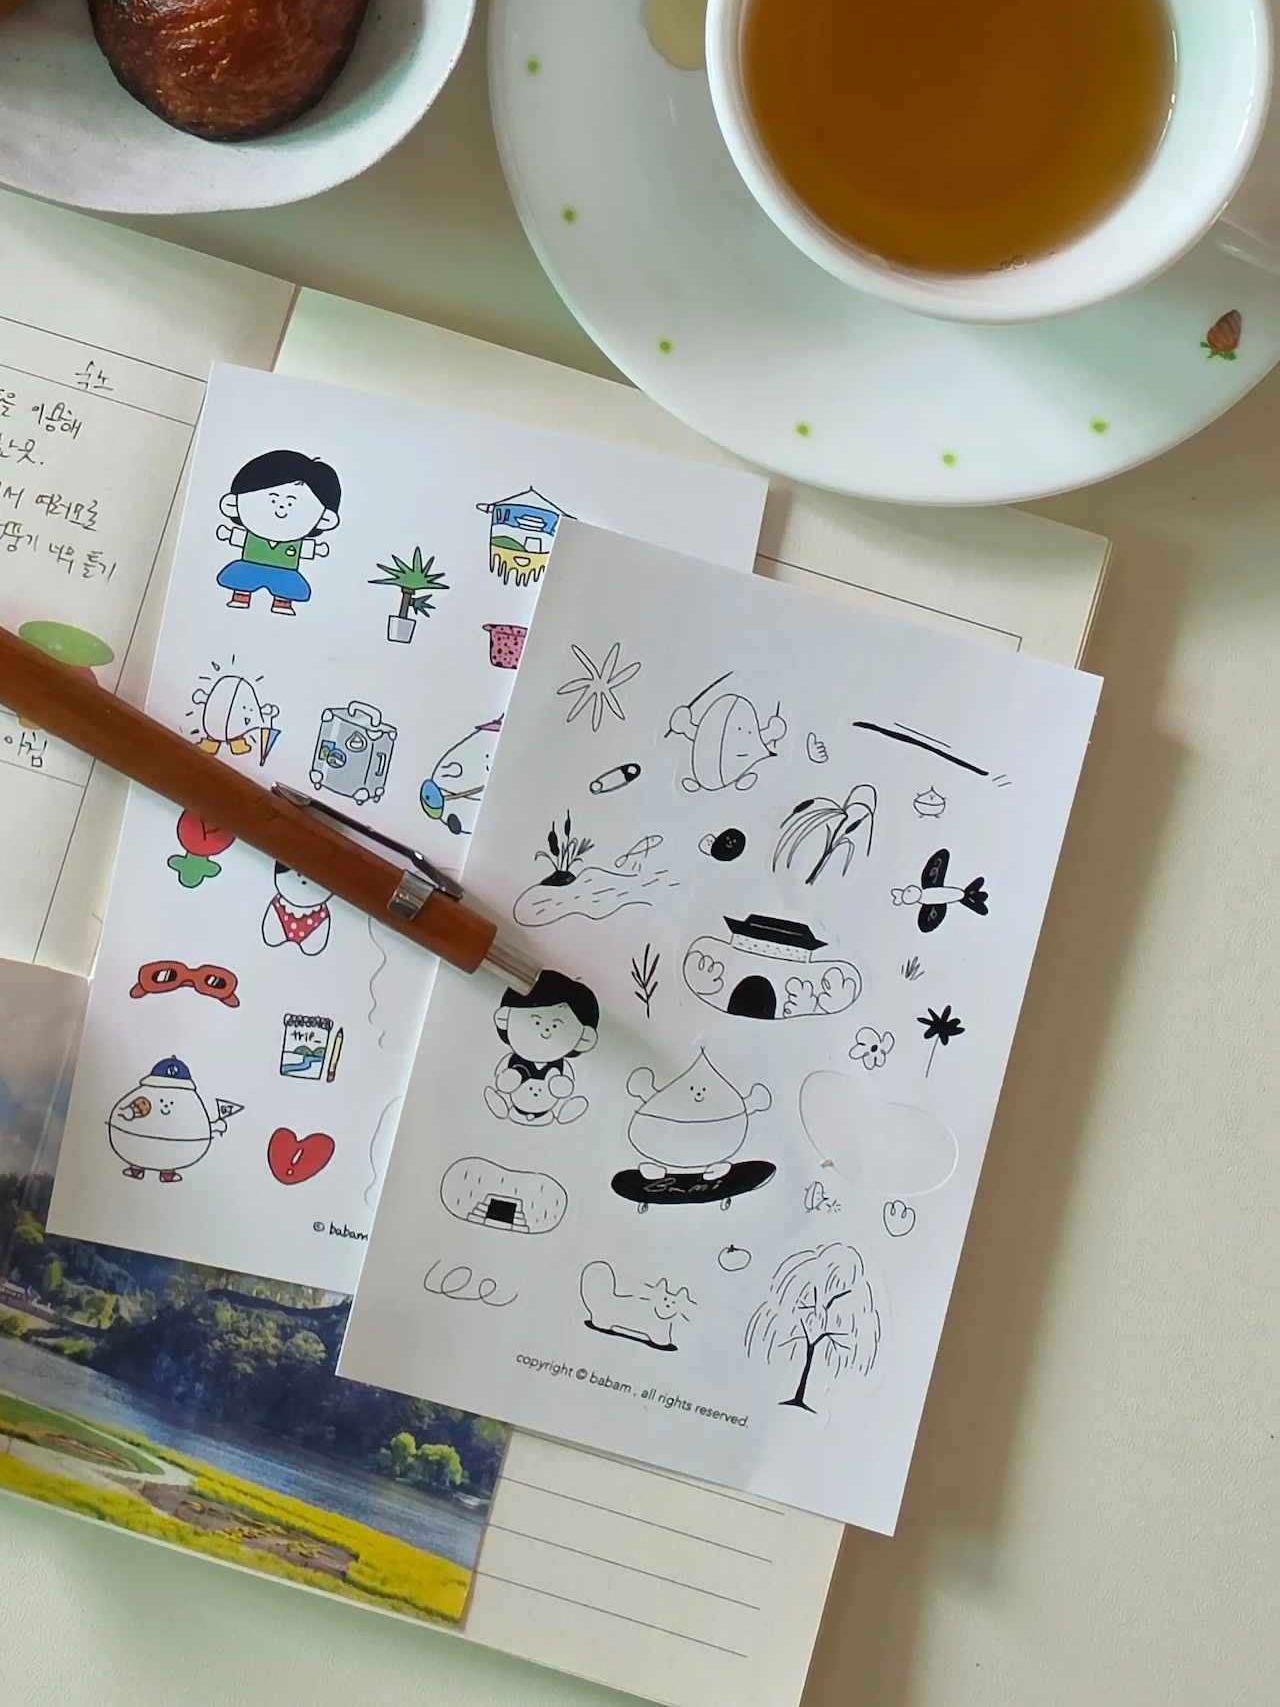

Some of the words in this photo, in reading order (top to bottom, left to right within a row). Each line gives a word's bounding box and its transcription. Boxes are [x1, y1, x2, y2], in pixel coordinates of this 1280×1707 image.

[32, 402, 82, 439] 이용해
[4, 731, 48, 768] 아침
[516, 1352, 574, 1379] copyright
[640, 1387, 656, 1400] all
[657, 1392, 693, 1413] rights
[694, 1403, 749, 1429] reserved.
